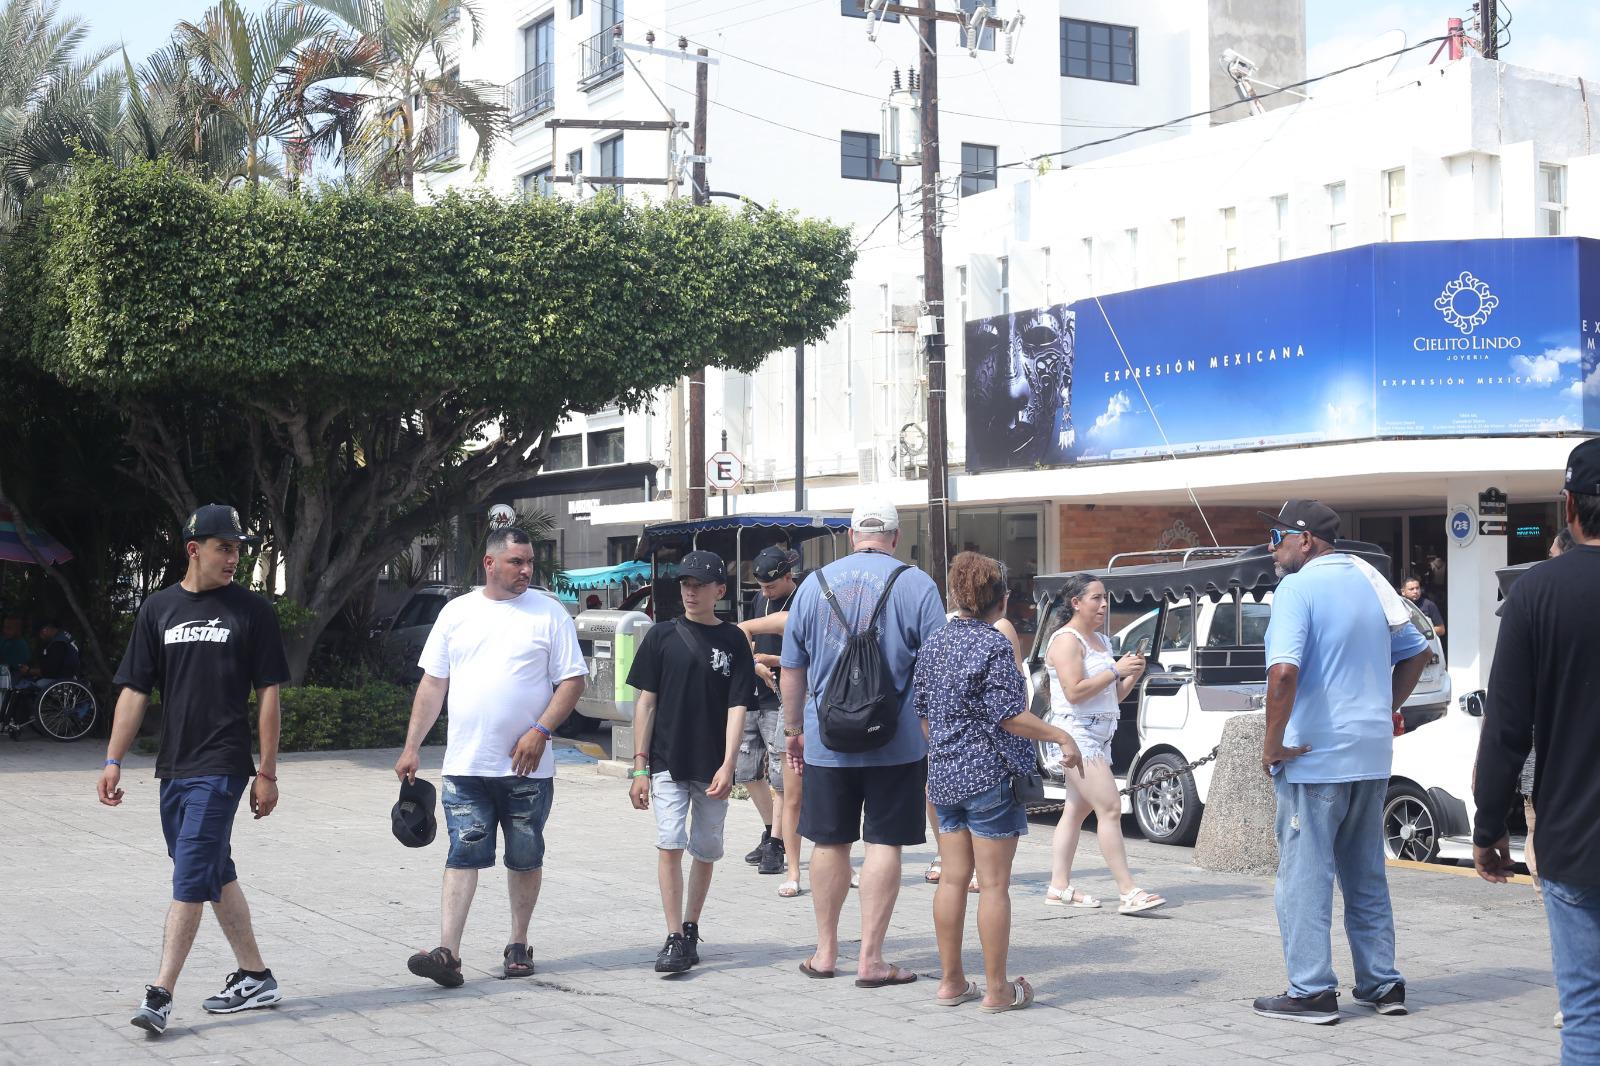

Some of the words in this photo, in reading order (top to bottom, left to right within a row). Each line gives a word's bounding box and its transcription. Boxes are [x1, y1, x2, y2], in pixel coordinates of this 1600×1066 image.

[1413, 336, 1470, 352] CIELITO
[1472, 335, 1521, 350] LINDO
[1104, 359, 1195, 383] EXPRESIÓN
[1209, 344, 1305, 369] MEXICANA
[1382, 376, 1465, 387] EXPRESIÓN
[1476, 375, 1553, 385] MEXICANA
[717, 461, 732, 481] E
[164, 626, 231, 645] HELLSTAR
